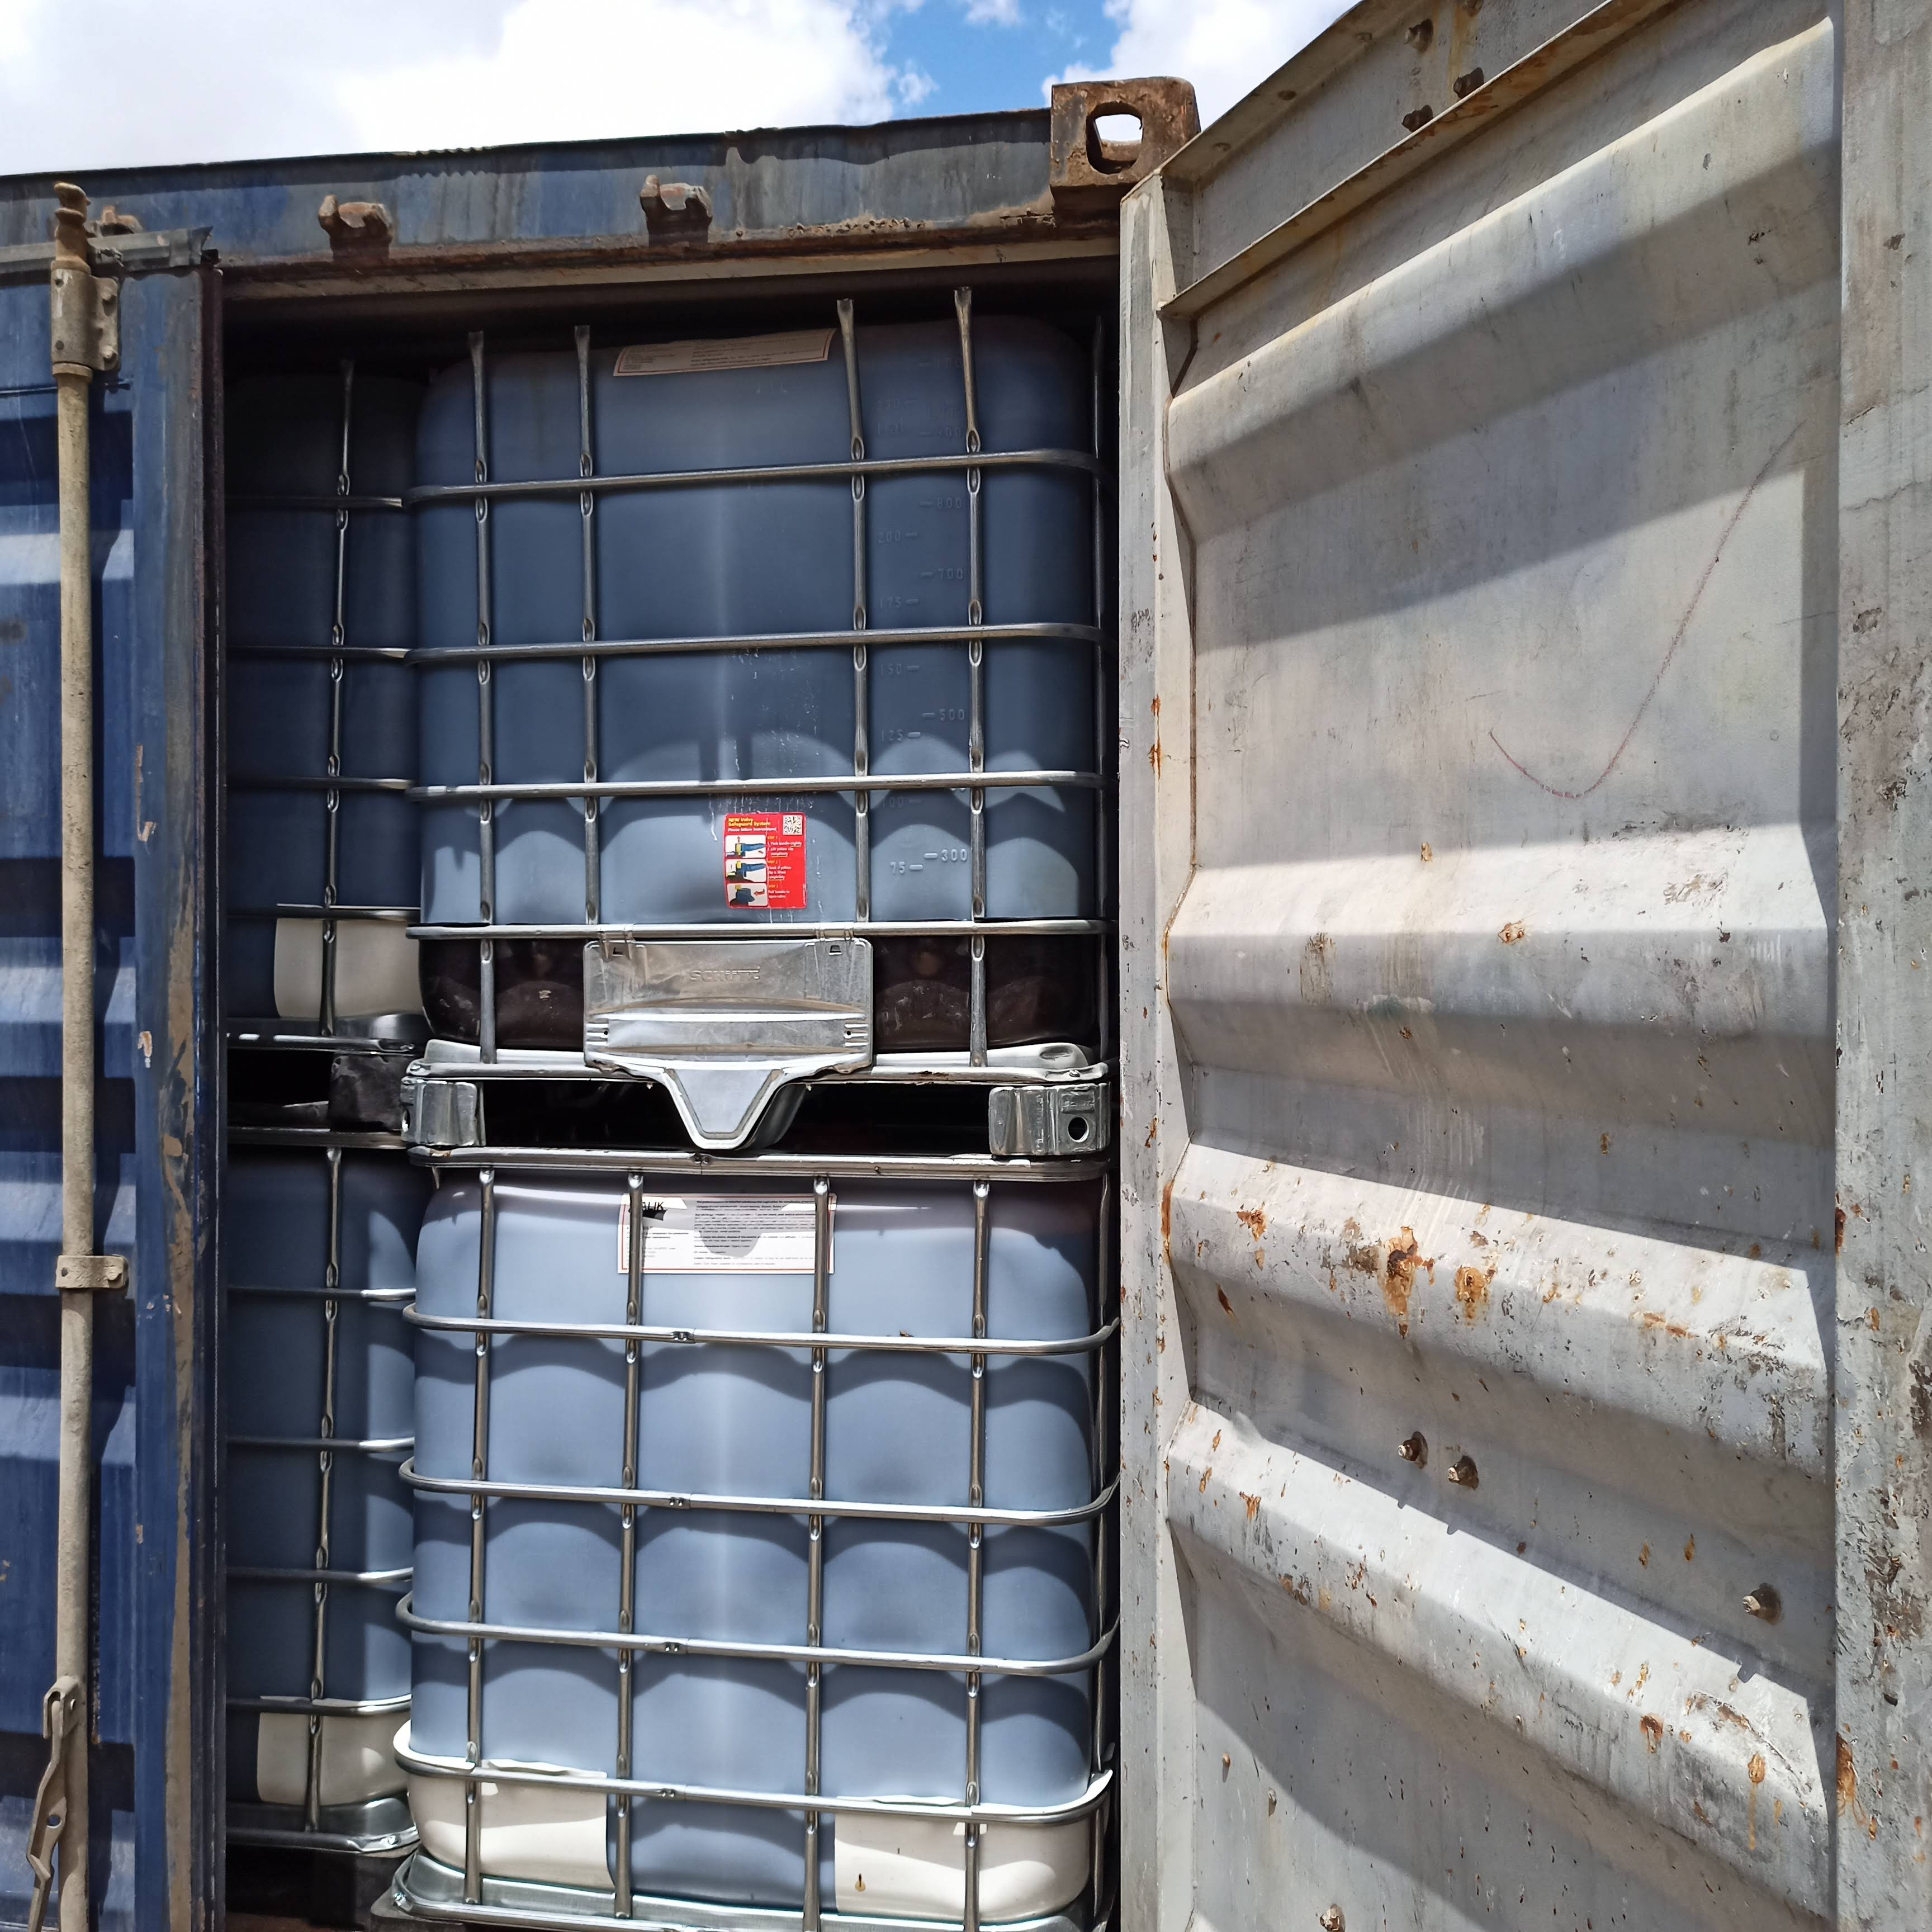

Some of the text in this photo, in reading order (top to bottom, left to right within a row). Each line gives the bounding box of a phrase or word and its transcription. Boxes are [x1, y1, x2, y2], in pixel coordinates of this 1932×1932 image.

[937, 567, 964, 581] 700
[939, 708, 965, 721] 500
[941, 848, 968, 861] 300
[890, 861, 906, 875] 75
